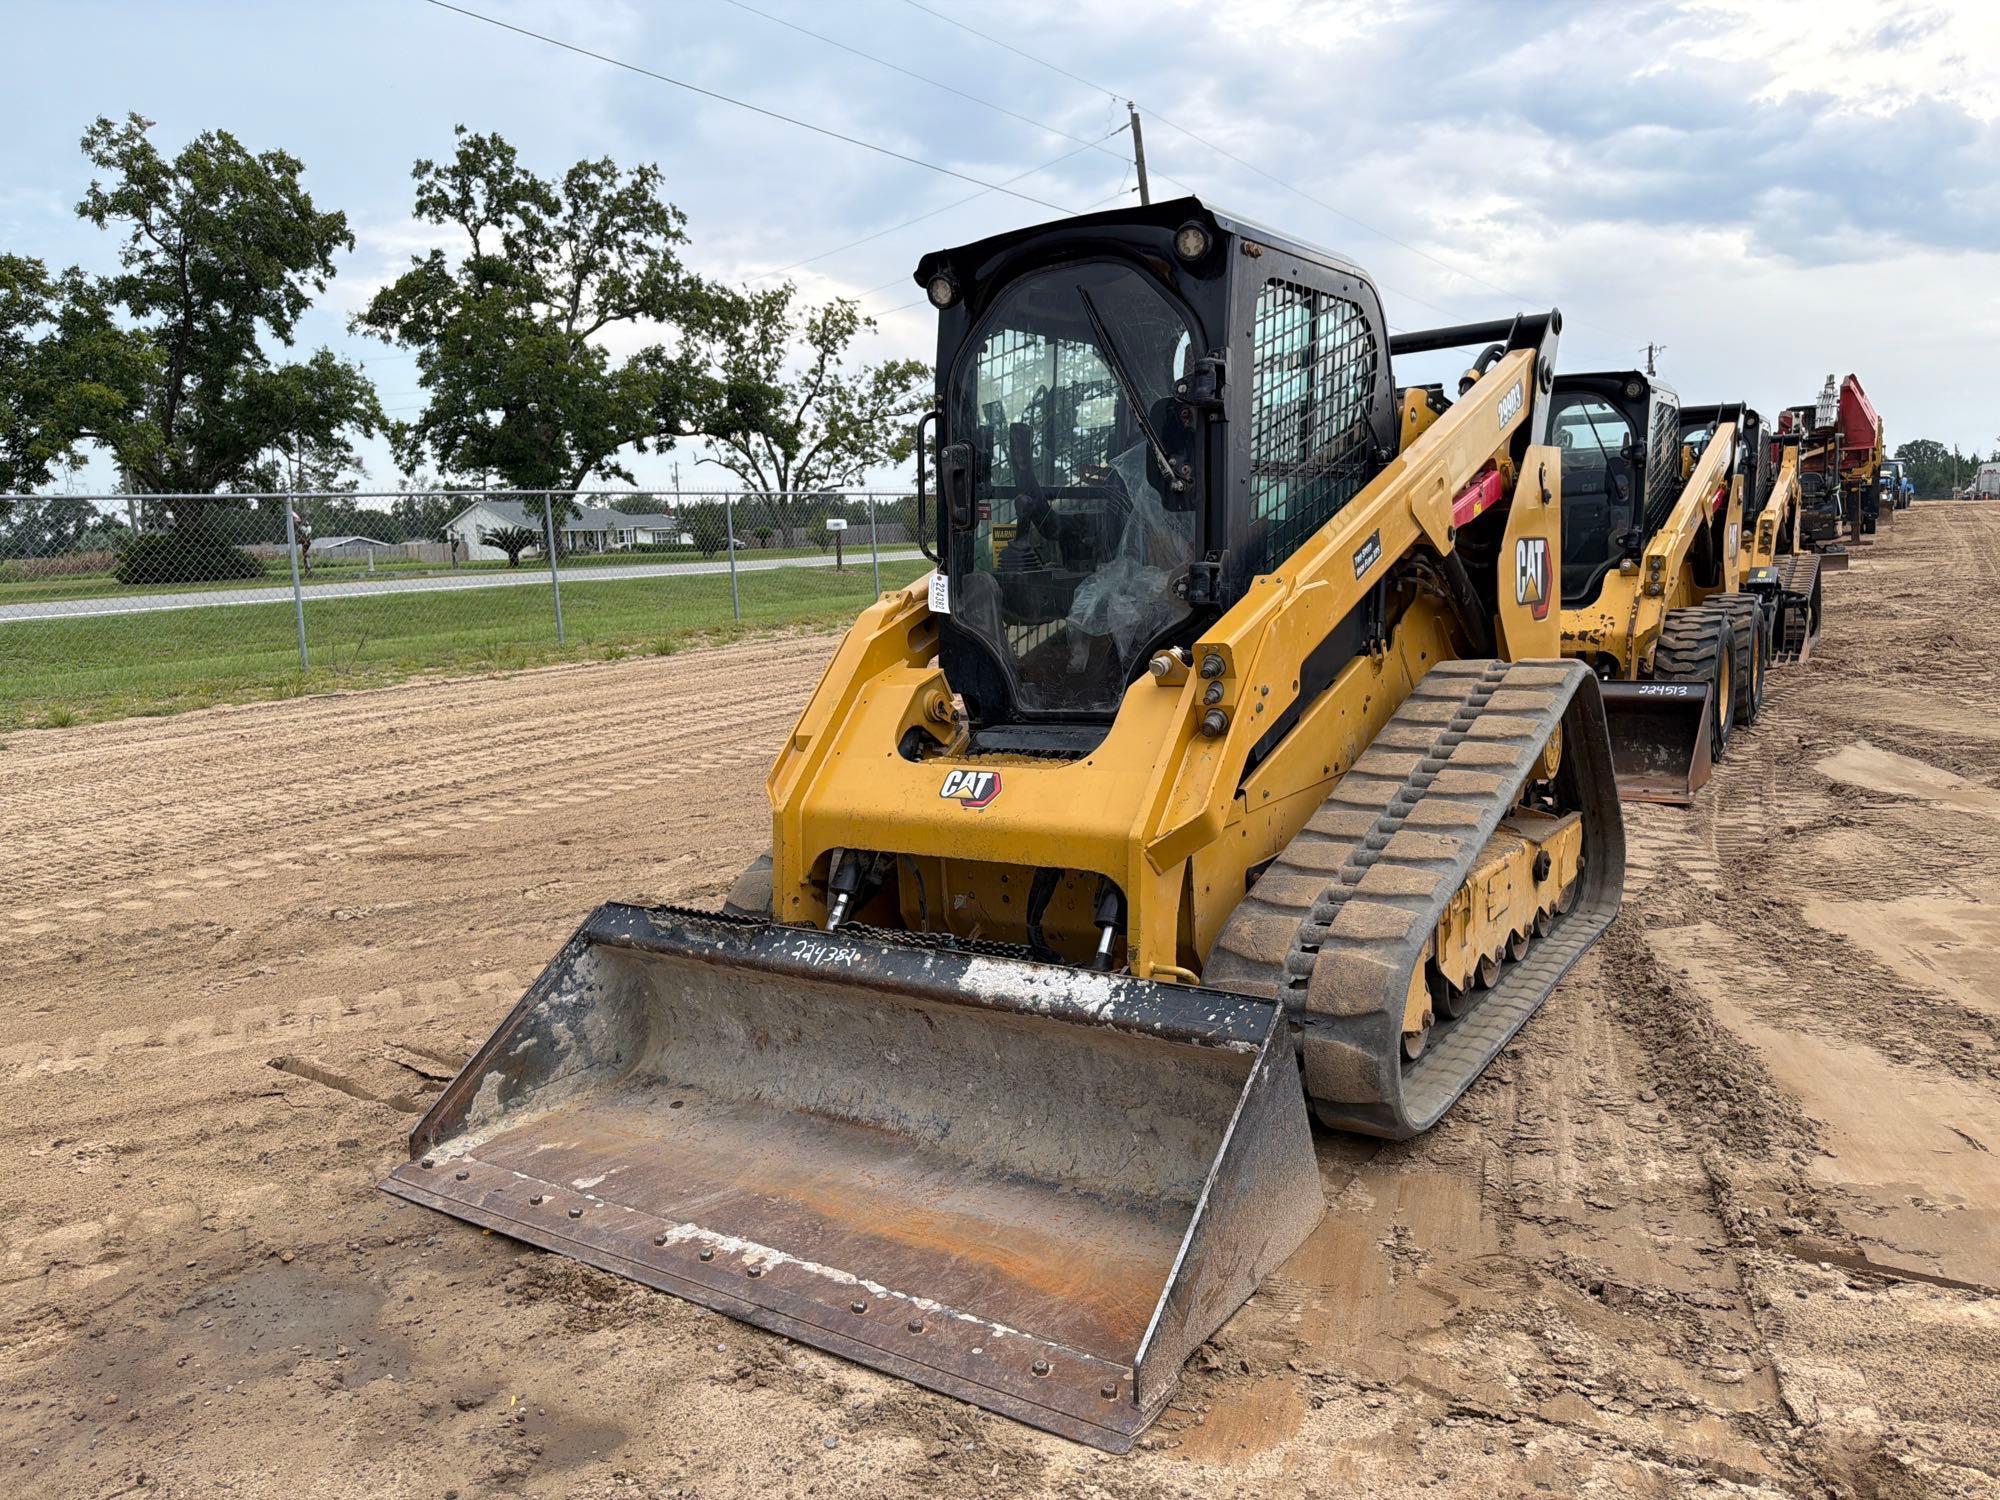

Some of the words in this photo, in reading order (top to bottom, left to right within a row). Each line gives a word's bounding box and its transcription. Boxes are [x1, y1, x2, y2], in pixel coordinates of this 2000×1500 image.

[1498, 383, 1521, 430] 299D3
[1516, 540, 1545, 603] CAT
[1638, 685, 1688, 696] 224513
[941, 770, 993, 799] CAT
[791, 940, 857, 967] 224382
